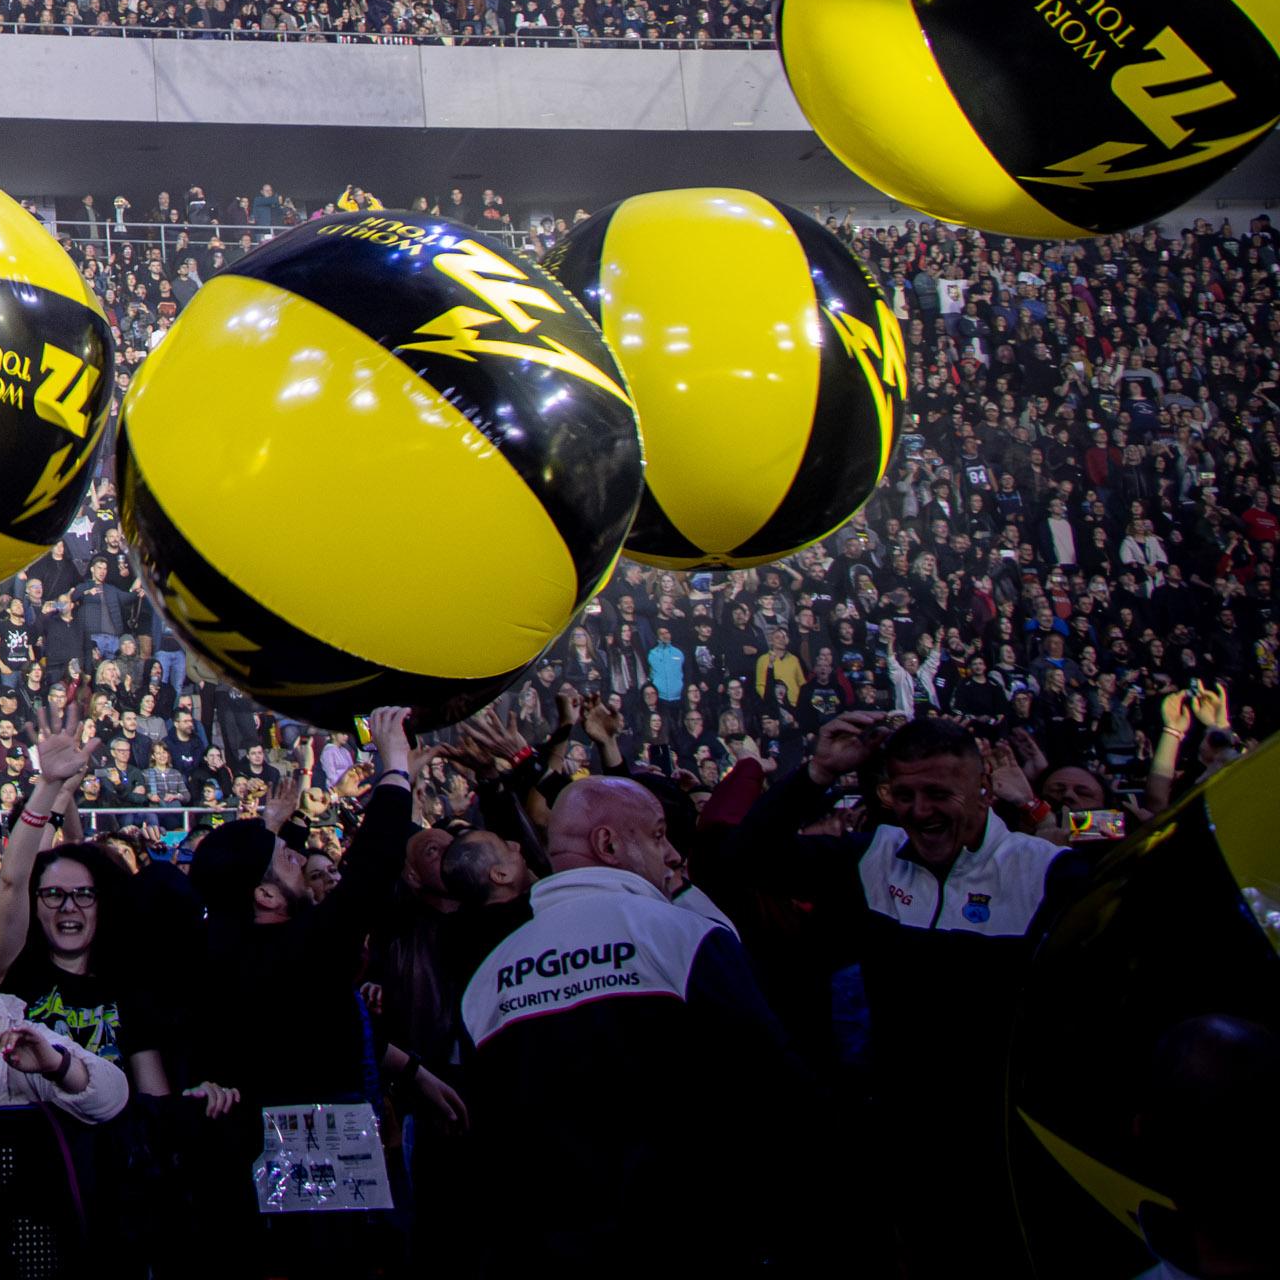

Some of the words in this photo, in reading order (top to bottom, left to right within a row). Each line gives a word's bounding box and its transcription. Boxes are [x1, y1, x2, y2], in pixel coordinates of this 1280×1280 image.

[316, 223, 424, 256] WORLD
[888, 884, 914, 906] RPG
[496, 942, 636, 994] RPGroup
[499, 988, 561, 1016] SECURITY
[563, 972, 641, 1000] SOLUTIONS
